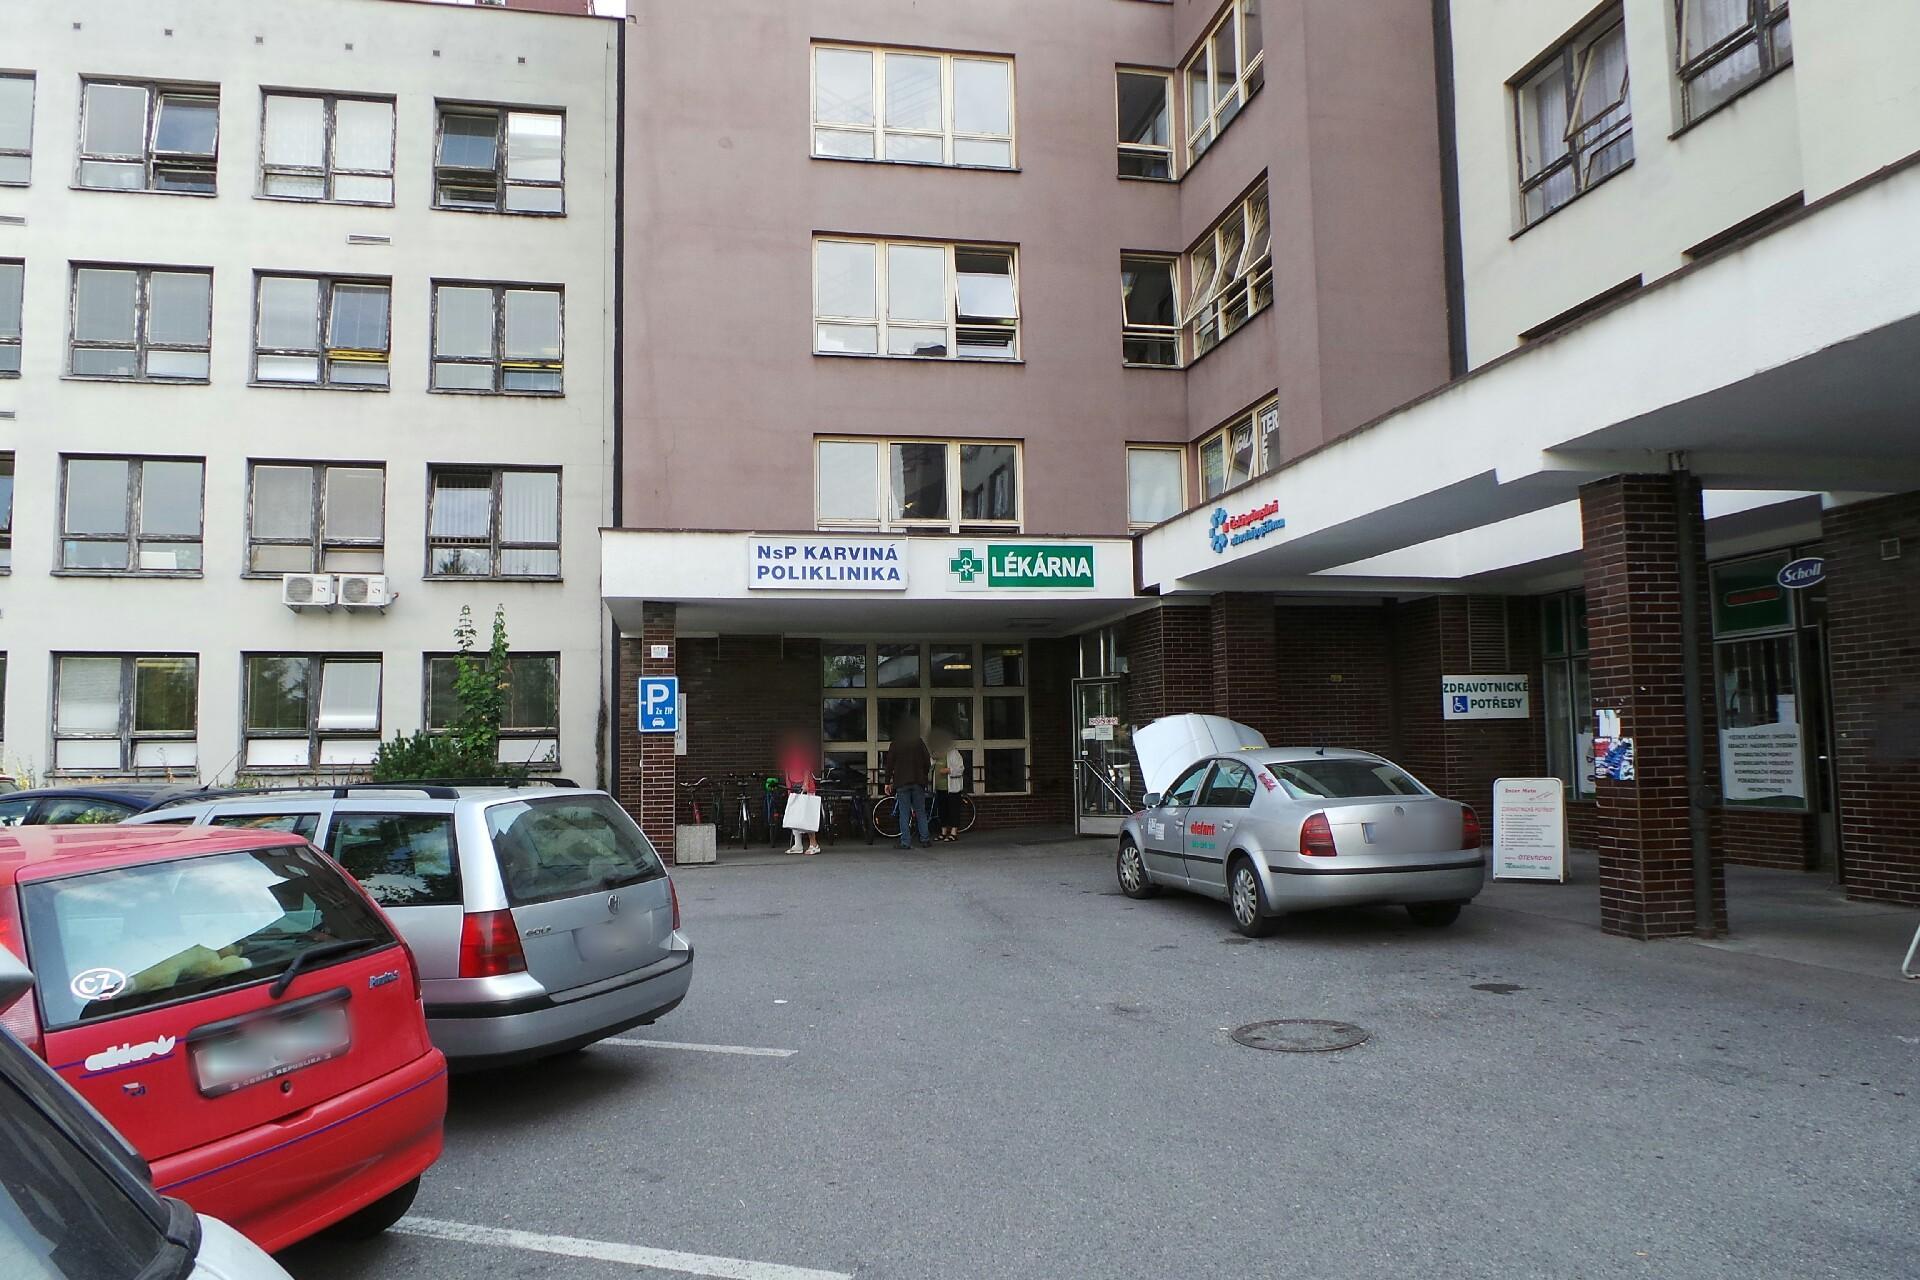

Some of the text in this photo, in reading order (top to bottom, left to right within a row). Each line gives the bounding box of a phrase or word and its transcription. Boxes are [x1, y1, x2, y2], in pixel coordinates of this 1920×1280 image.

[757, 543, 898, 561] NsP KARVINÁ
[757, 565, 901, 581] POLIKLINIKA
[991, 551, 1092, 577] LÉKÁRNA
[1784, 562, 1822, 583] Scholl
[647, 684, 670, 715] P
[1470, 695, 1523, 709] POTŘEBY
[1190, 820, 1216, 836] elefant
[80, 973, 115, 994] CZ
